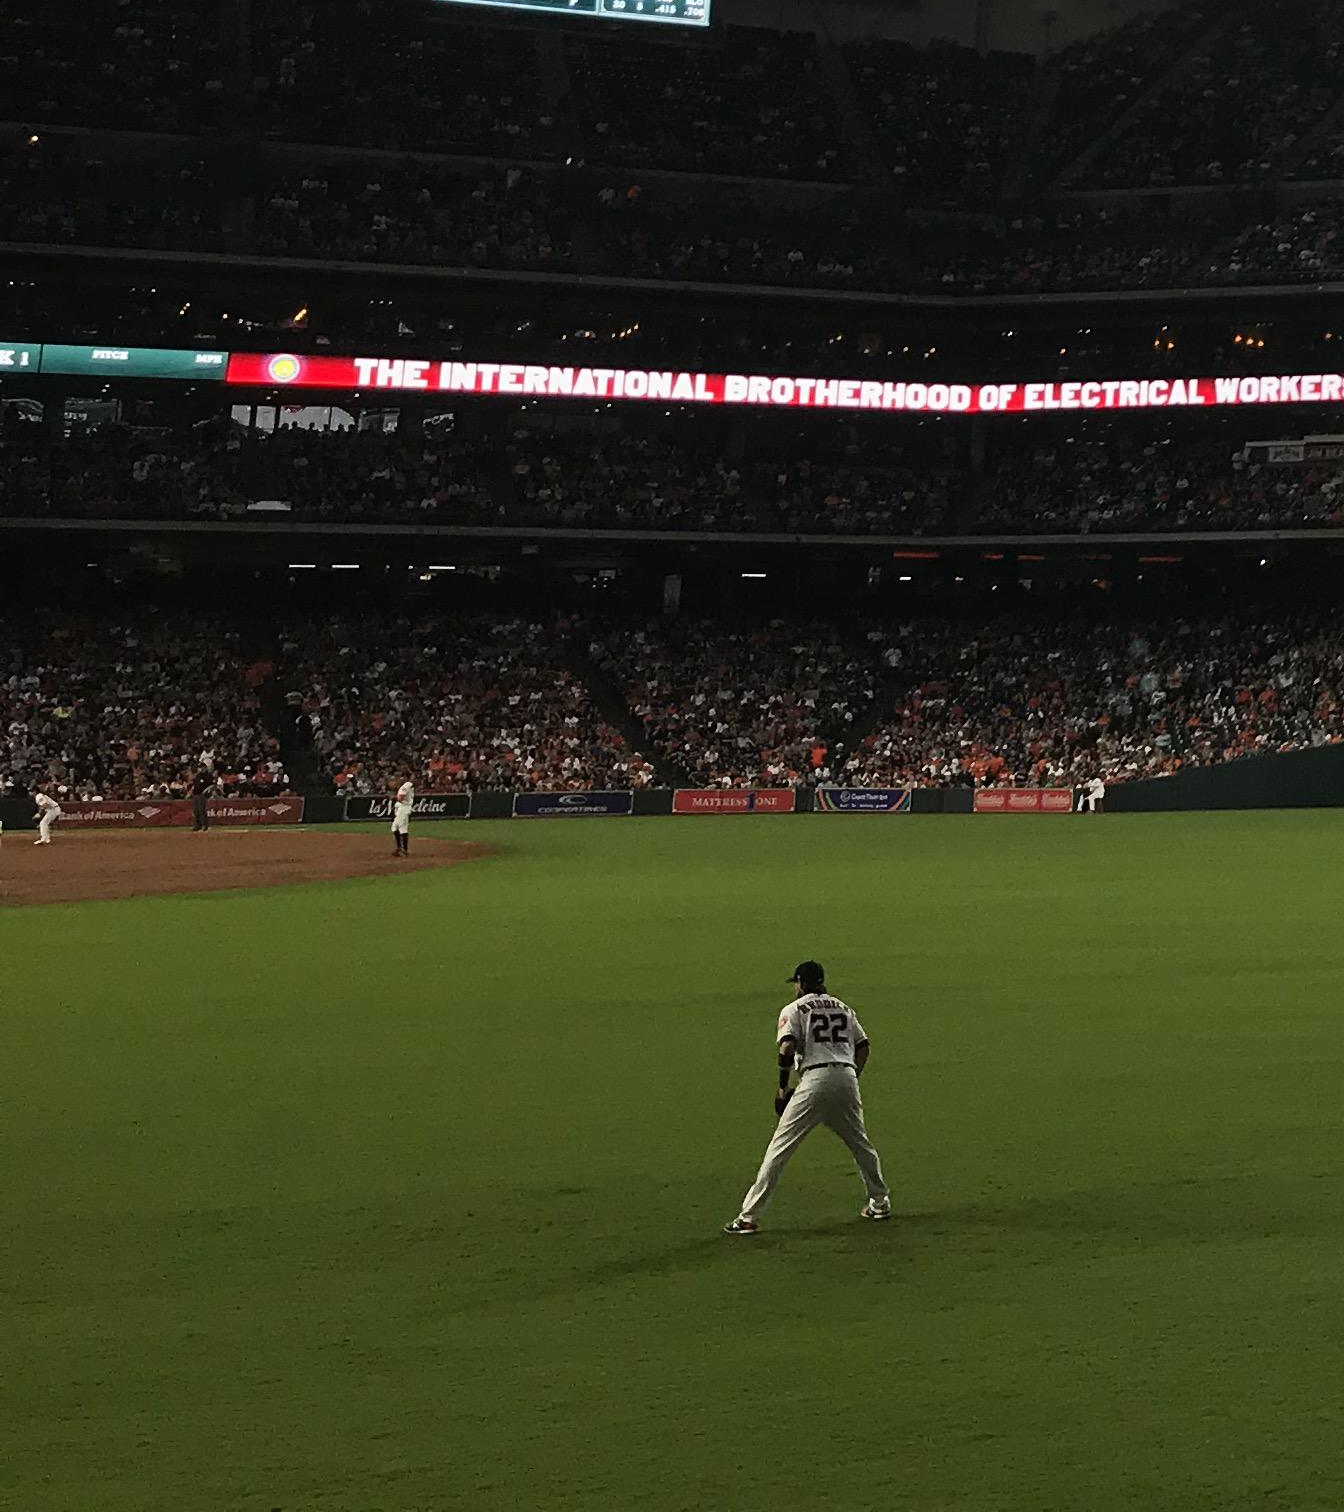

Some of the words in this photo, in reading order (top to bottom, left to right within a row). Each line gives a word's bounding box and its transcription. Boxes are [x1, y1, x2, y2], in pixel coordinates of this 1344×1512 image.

[92, 349, 129, 360] PITCH
[195, 354, 222, 364] MPH
[354, 357, 428, 389] THE
[439, 361, 714, 402] INTERNATIONAL
[724, 374, 972, 411] BROTHERHOOD
[978, 384, 1013, 410] OF
[1024, 377, 1205, 408] ELECTRICAL
[692, 797, 748, 807] MATTRESS
[755, 796, 778, 806] ONE
[93, 810, 135, 820] America
[227, 807, 266, 817] America
[811, 1013, 849, 1043] 22
